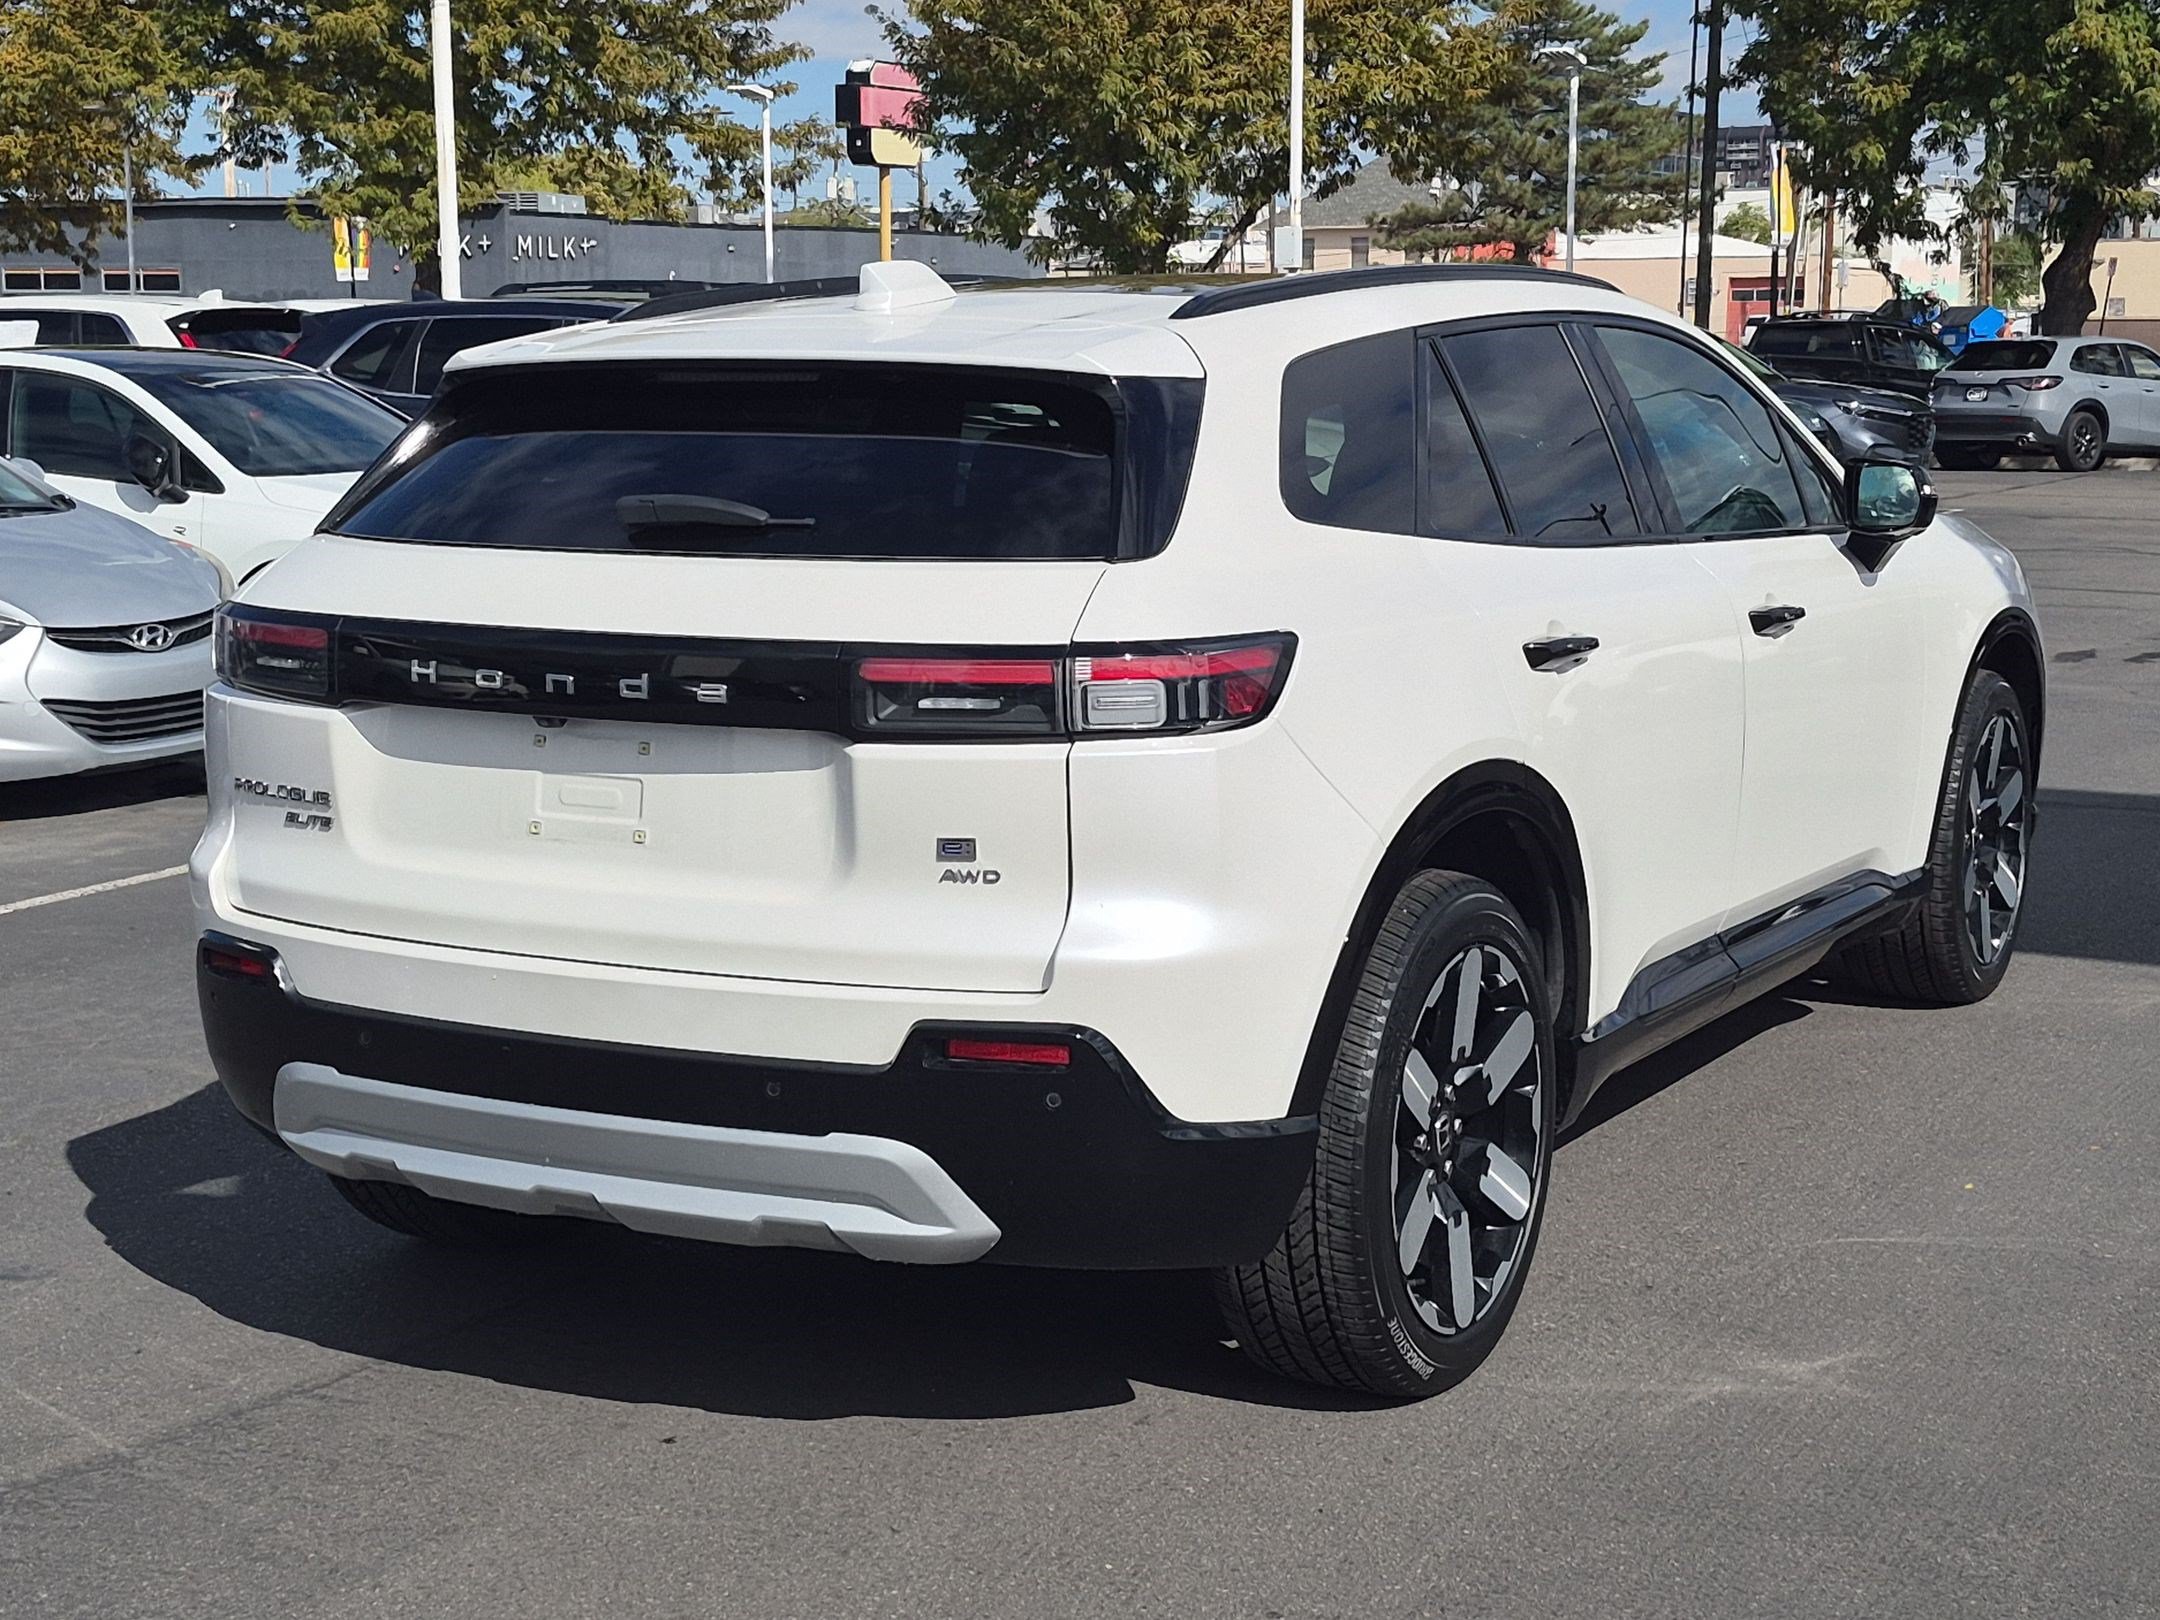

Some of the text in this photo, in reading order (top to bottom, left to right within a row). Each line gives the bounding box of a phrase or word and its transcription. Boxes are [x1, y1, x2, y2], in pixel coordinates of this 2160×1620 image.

[517, 234, 591, 259] MILK+
[234, 777, 332, 805] PROLOGUE
[285, 811, 333, 829] ELITE
[938, 868, 1001, 885] AWD
[1386, 1316, 1435, 1381] BRIDGESTONE
